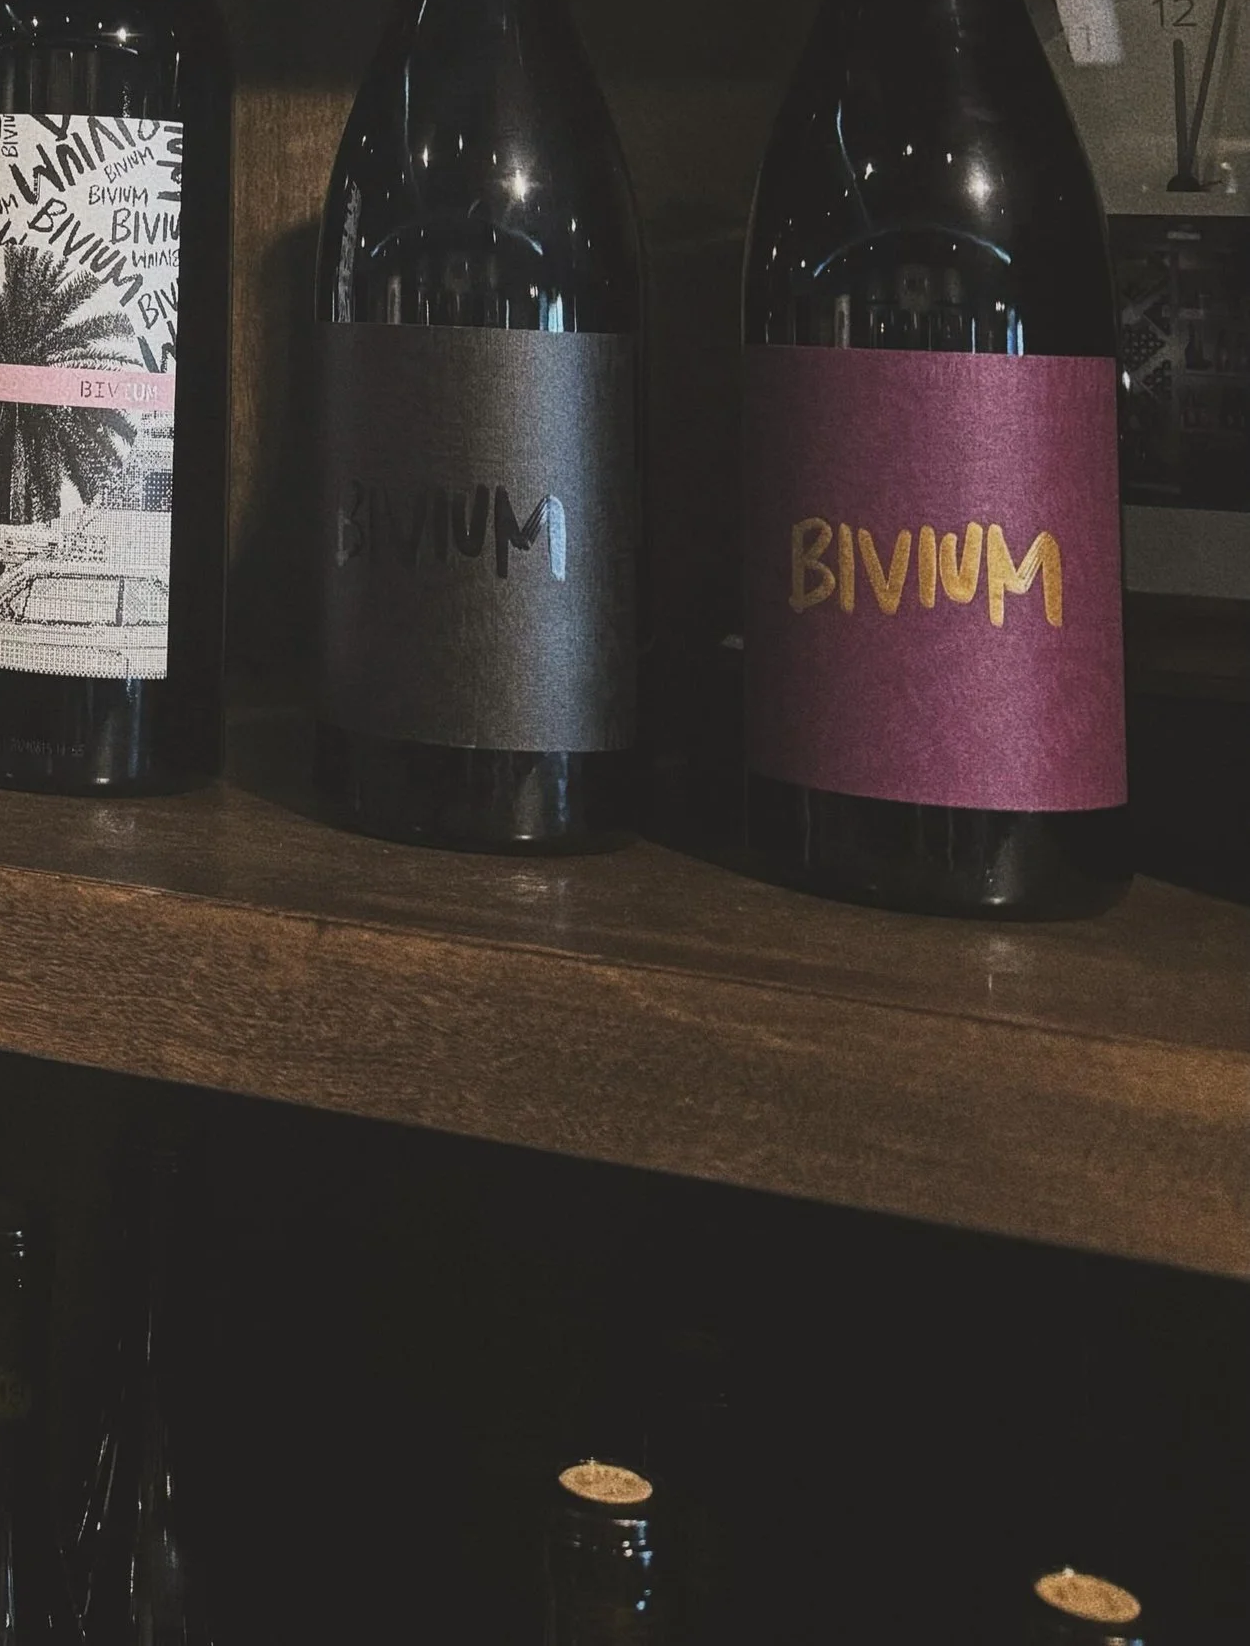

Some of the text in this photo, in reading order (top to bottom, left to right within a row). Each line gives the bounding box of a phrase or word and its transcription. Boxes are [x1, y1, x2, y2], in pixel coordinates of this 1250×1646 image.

[88, 184, 149, 205] BIVIUM
[104, 146, 155, 183] BIVIUM
[28, 198, 144, 307] BIVIUM
[335, 480, 567, 582] BIVIUM
[788, 517, 1063, 628] BIVIUM
